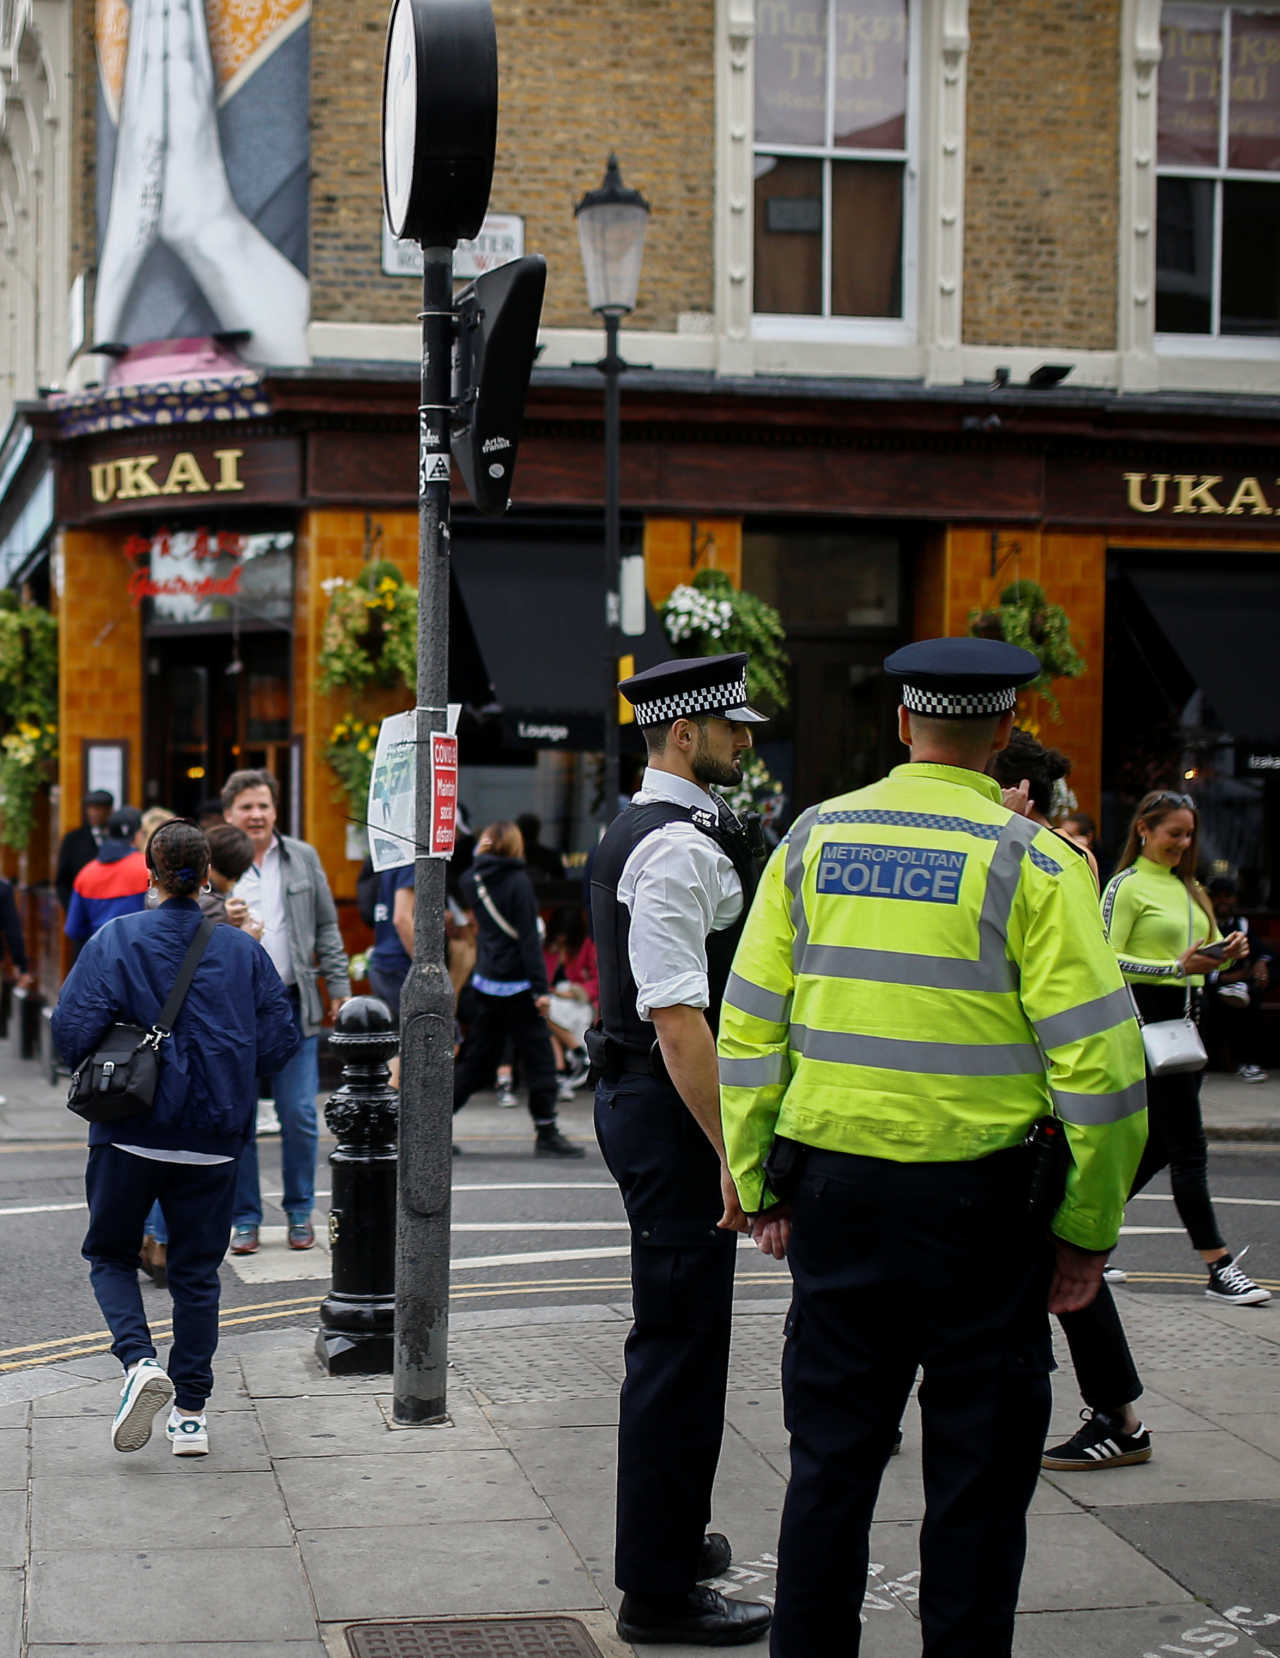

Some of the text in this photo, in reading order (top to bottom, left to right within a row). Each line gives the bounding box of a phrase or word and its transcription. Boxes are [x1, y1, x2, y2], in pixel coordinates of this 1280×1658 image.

[90, 449, 245, 502] UKAI
[518, 721, 569, 741] Lounge
[440, 803, 453, 821] social
[823, 845, 964, 869] METROPOLITAN
[817, 861, 960, 900] POLICE
